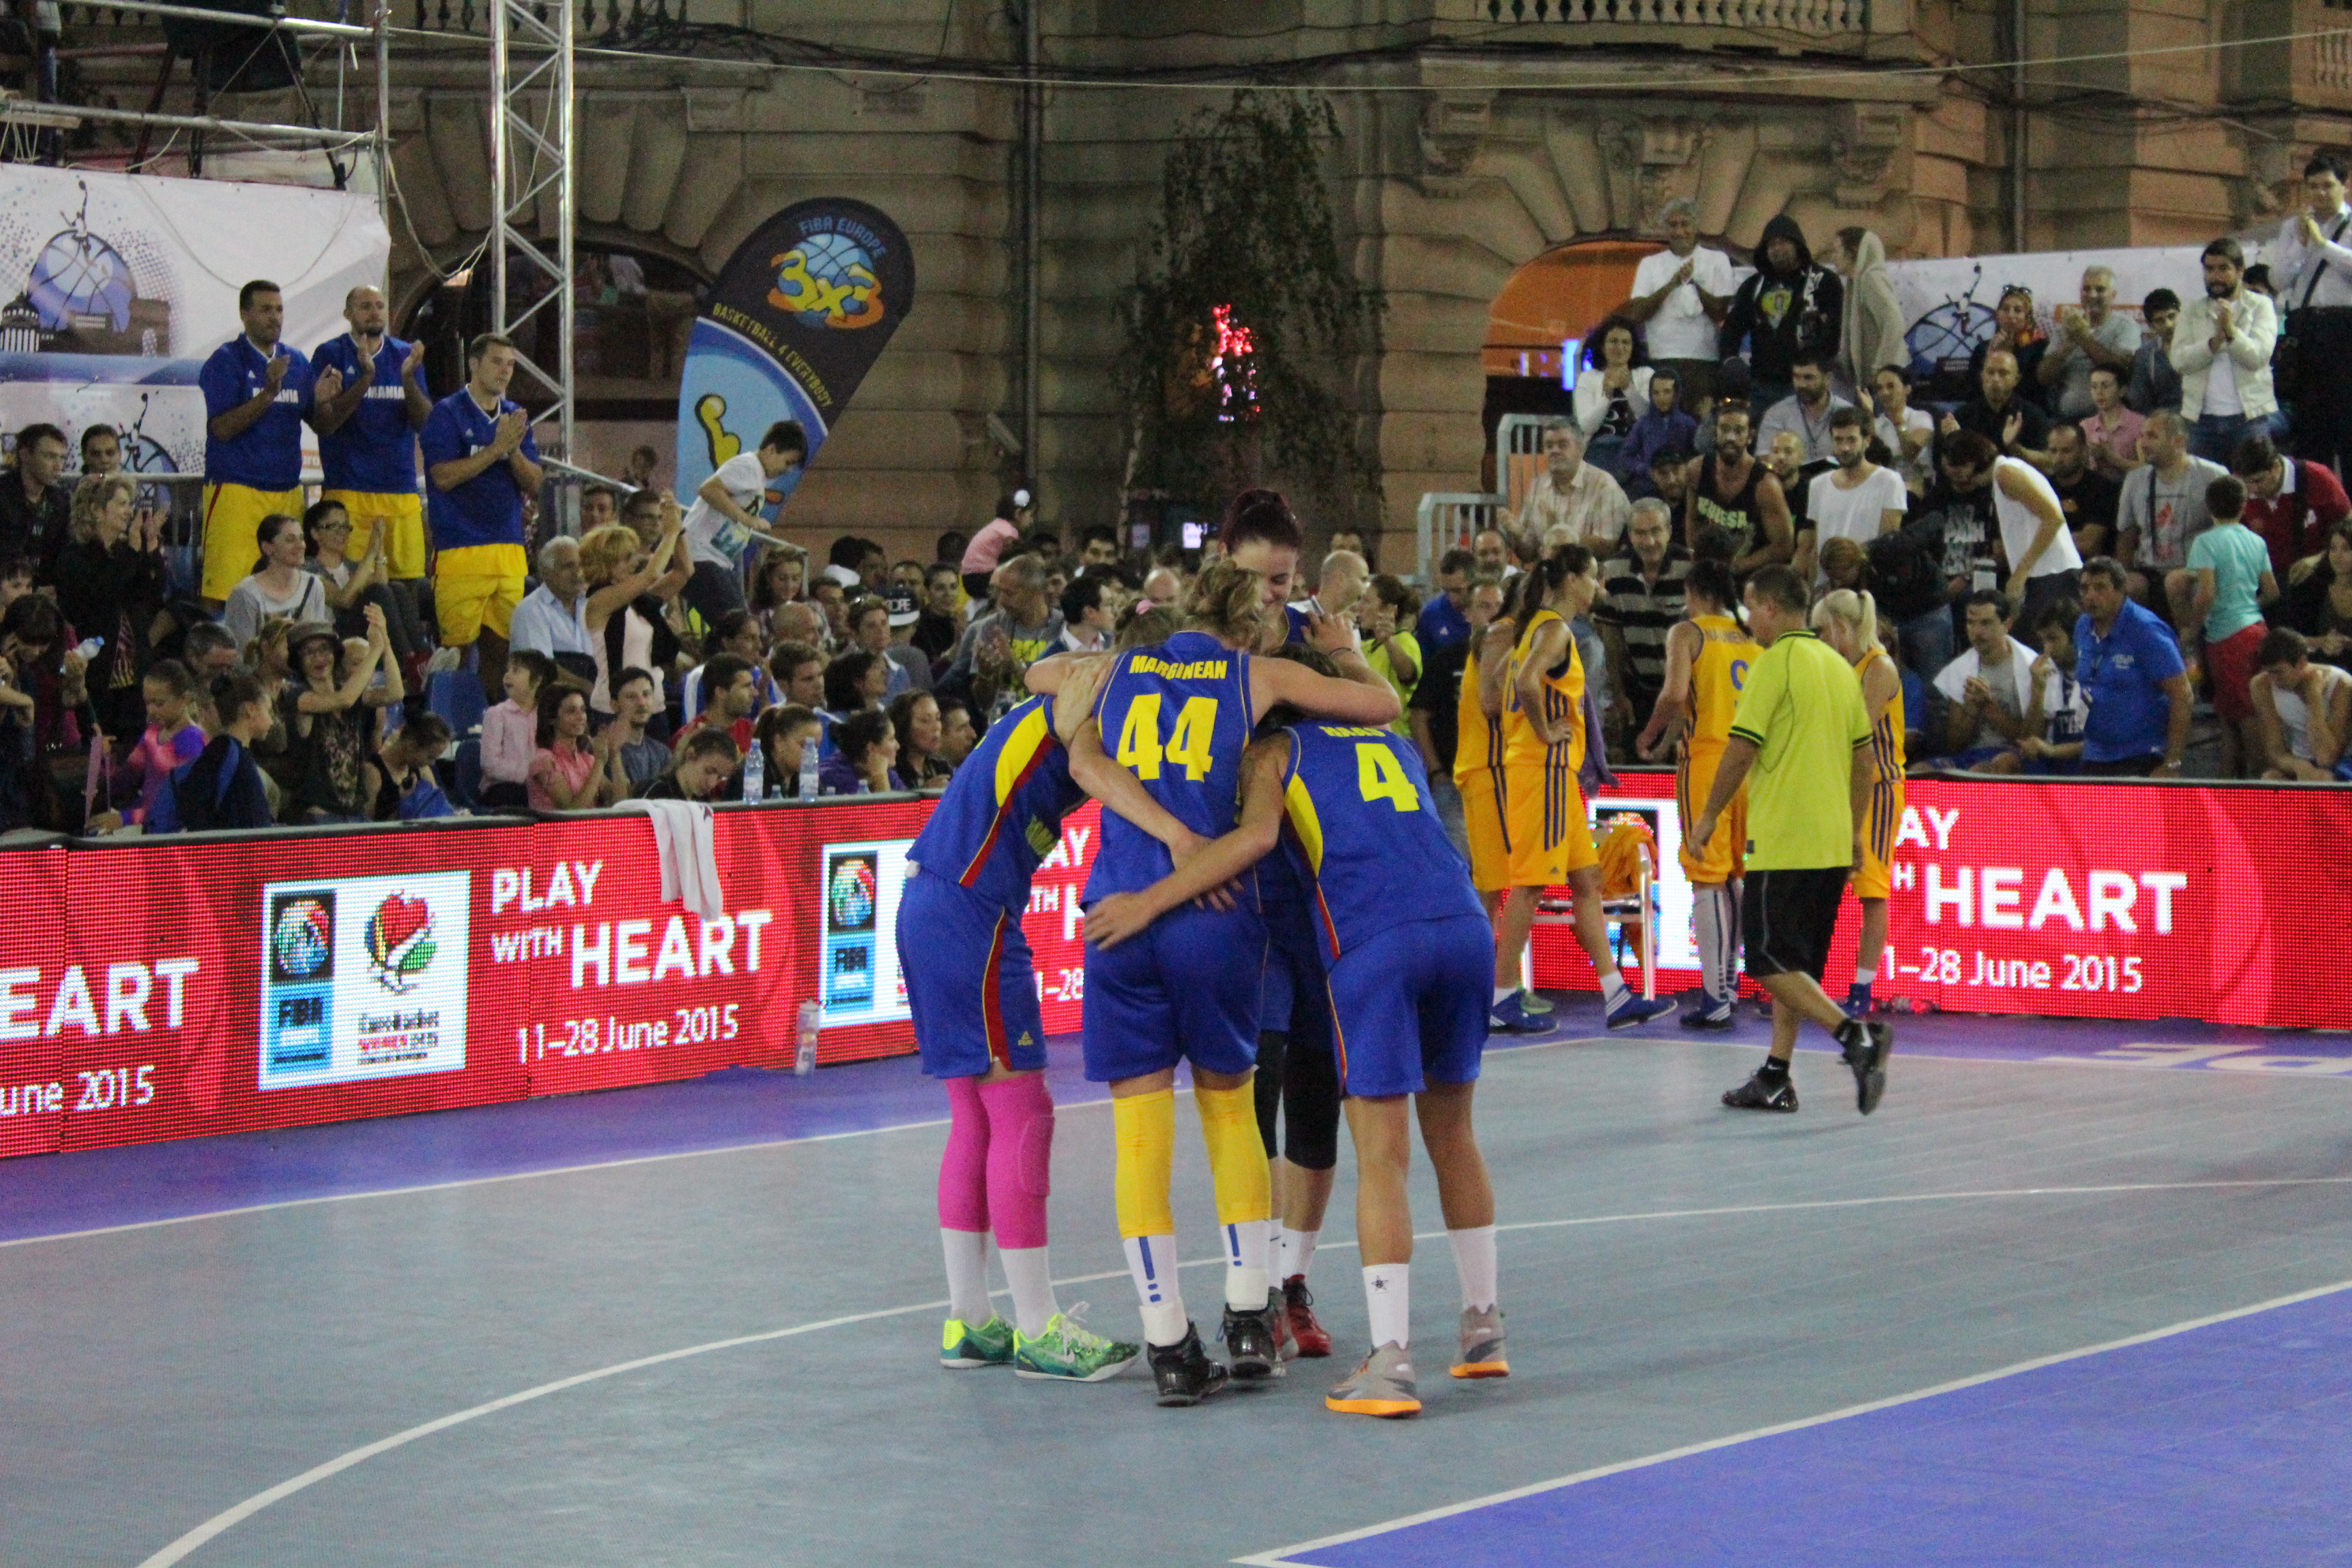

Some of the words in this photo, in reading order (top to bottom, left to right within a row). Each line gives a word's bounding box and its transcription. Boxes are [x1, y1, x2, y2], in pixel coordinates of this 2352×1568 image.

[798, 215, 833, 235] FIBA
[836, 216, 887, 260] EUROPE
[713, 302, 778, 348] BASKETBALL
[779, 344, 789, 355] 4
[785, 350, 834, 408] EVERYBODY
[1129, 655, 1228, 680] MARGINEAN
[1116, 693, 1219, 782] 44
[1354, 743, 1420, 812] 4
[1894, 805, 1960, 850] AY
[491, 859, 604, 914] PLAY
[1925, 862, 2187, 936] HEART
[491, 924, 564, 964] WITH
[570, 909, 773, 989] HEART
[1967, 950, 2051, 990] June
[2061, 953, 2144, 994] 2015
[0, 957, 199, 1043] EART
[602, 1015, 668, 1054] June
[674, 1003, 739, 1045] 2015
[75, 1064, 155, 1111] 2015
